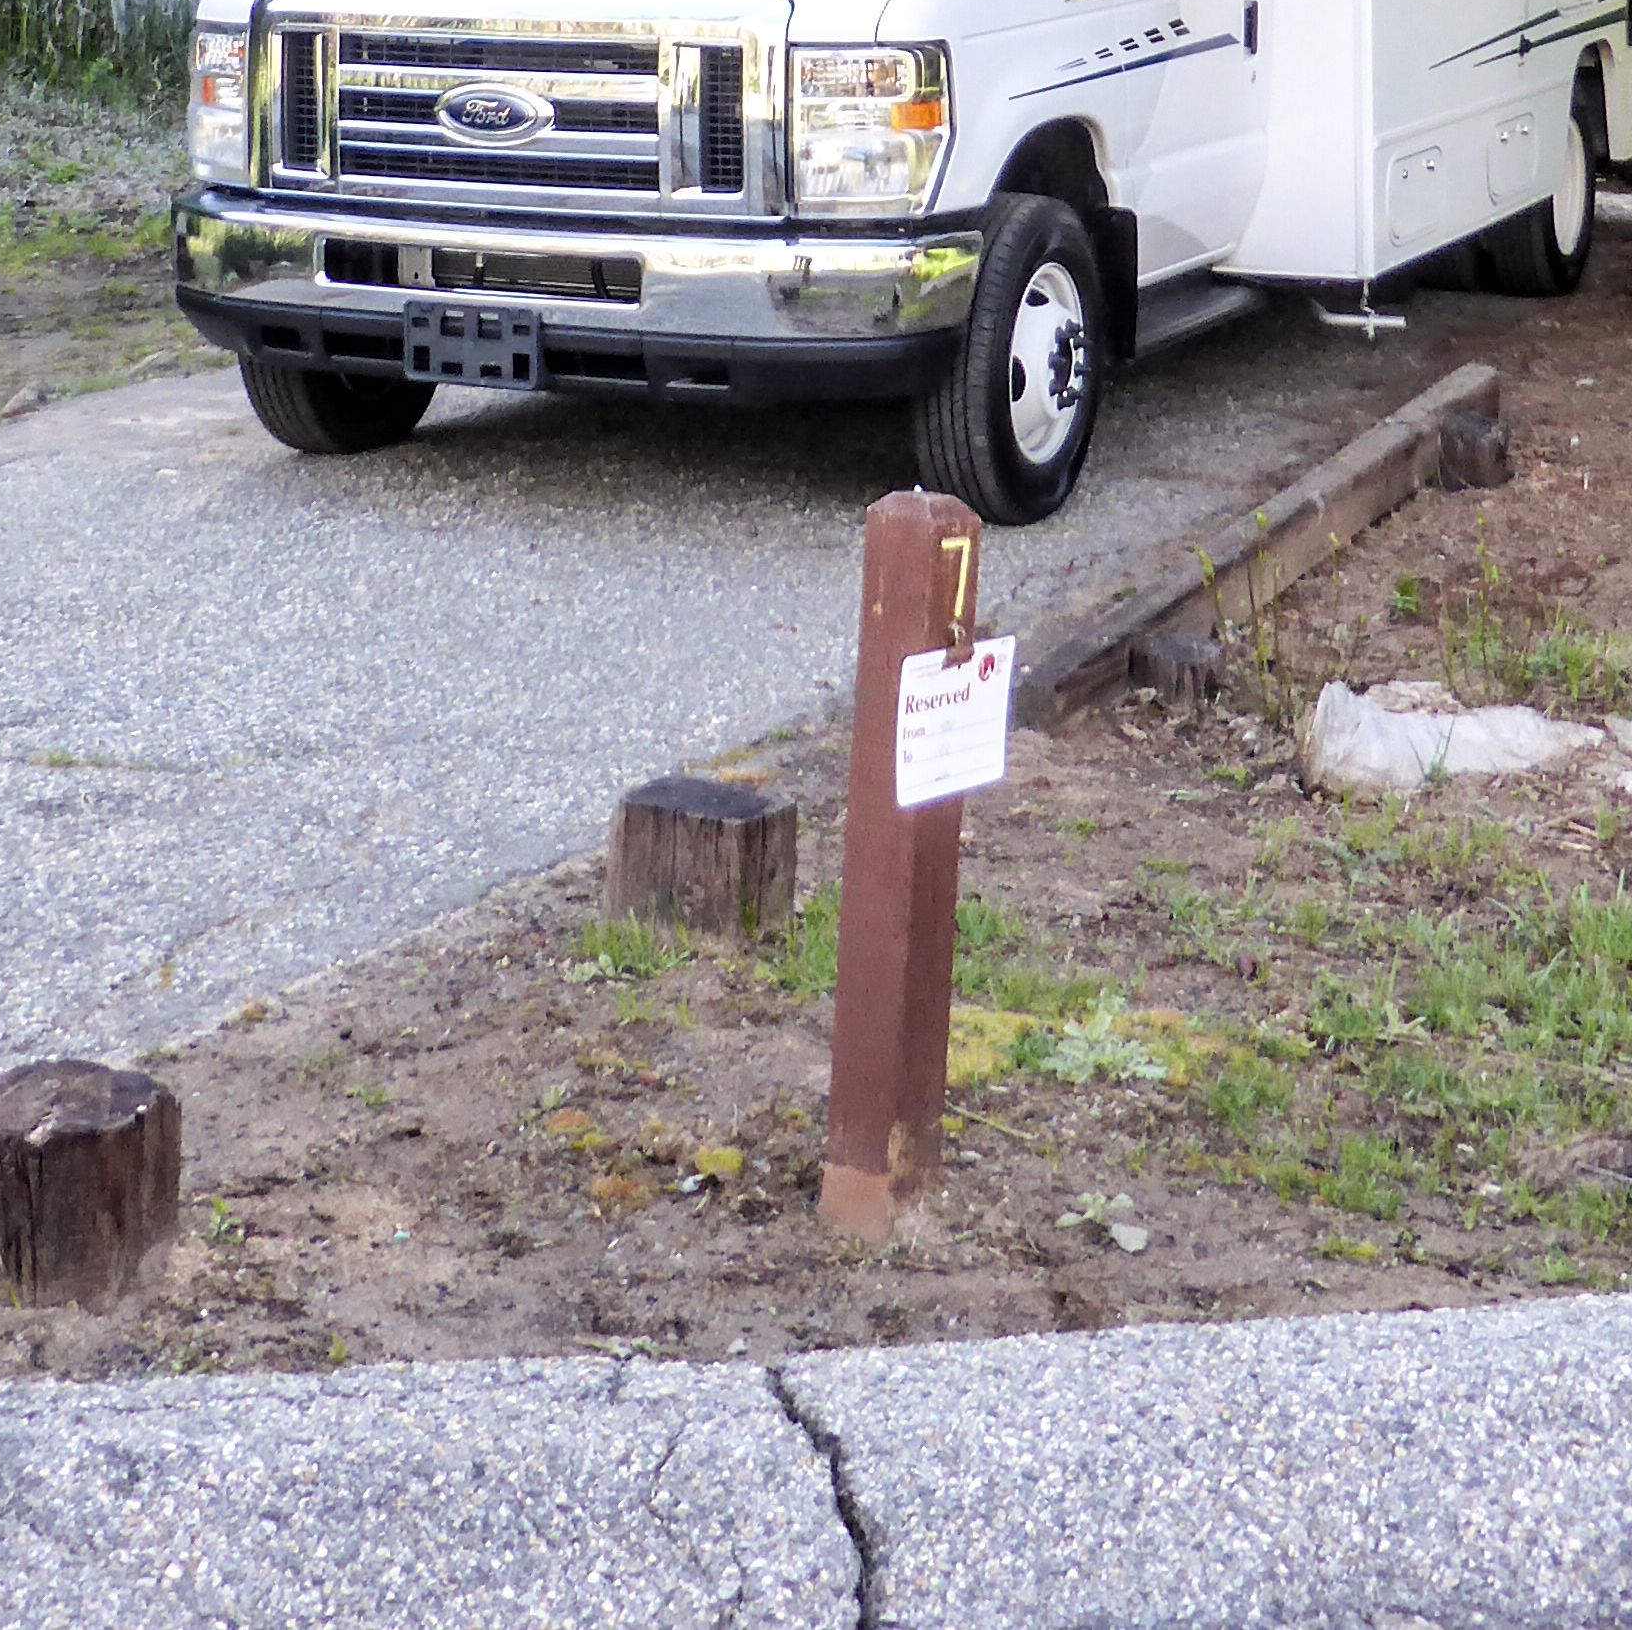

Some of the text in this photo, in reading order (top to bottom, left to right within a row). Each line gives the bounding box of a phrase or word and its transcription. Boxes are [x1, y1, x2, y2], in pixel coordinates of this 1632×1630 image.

[461, 99, 511, 125] Ford
[940, 537, 971, 619] 7
[904, 682, 971, 715] Reserved
[902, 725, 926, 740] From
